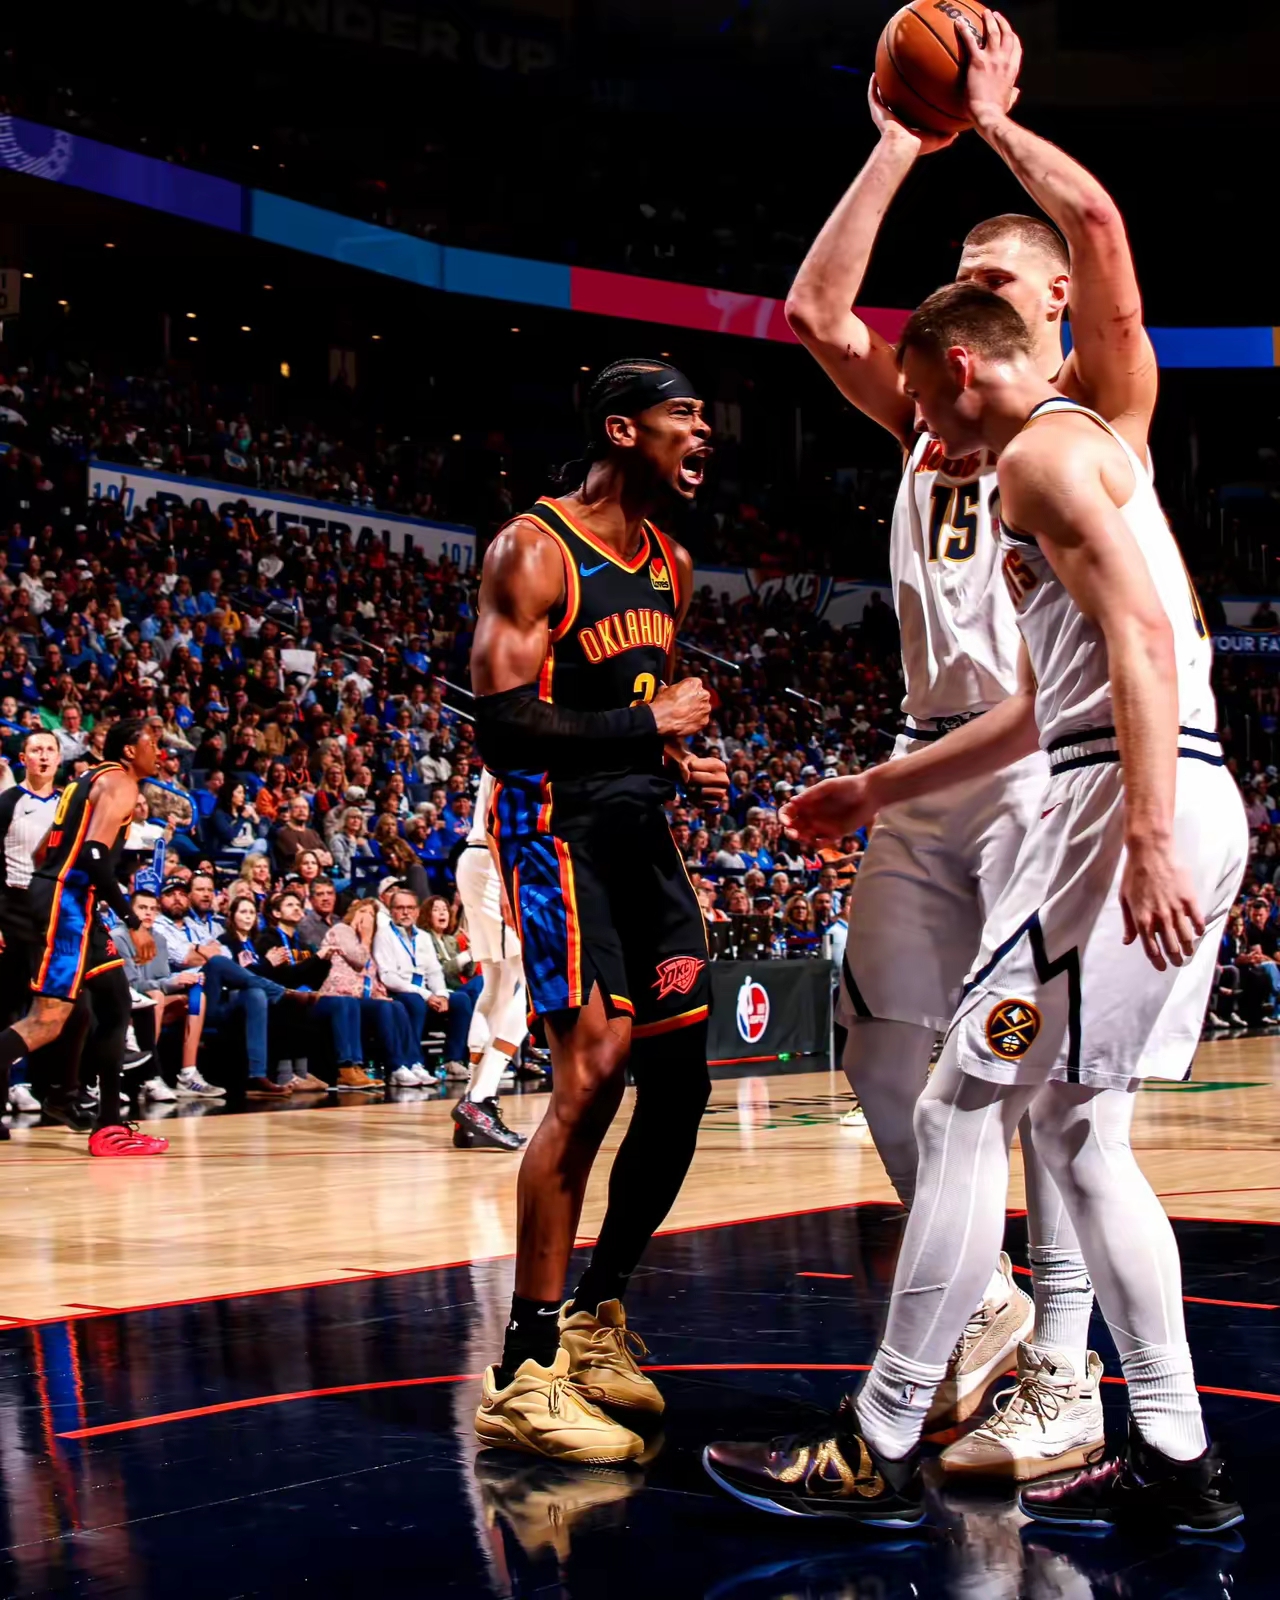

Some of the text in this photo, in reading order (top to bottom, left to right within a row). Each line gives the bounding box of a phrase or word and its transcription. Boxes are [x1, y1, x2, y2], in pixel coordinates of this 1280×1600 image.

[188, 0, 557, 75] UNDER UP
[928, 483, 981, 563] 15
[1260, 637, 1280, 652] FA
[629, 672, 656, 708] 2
